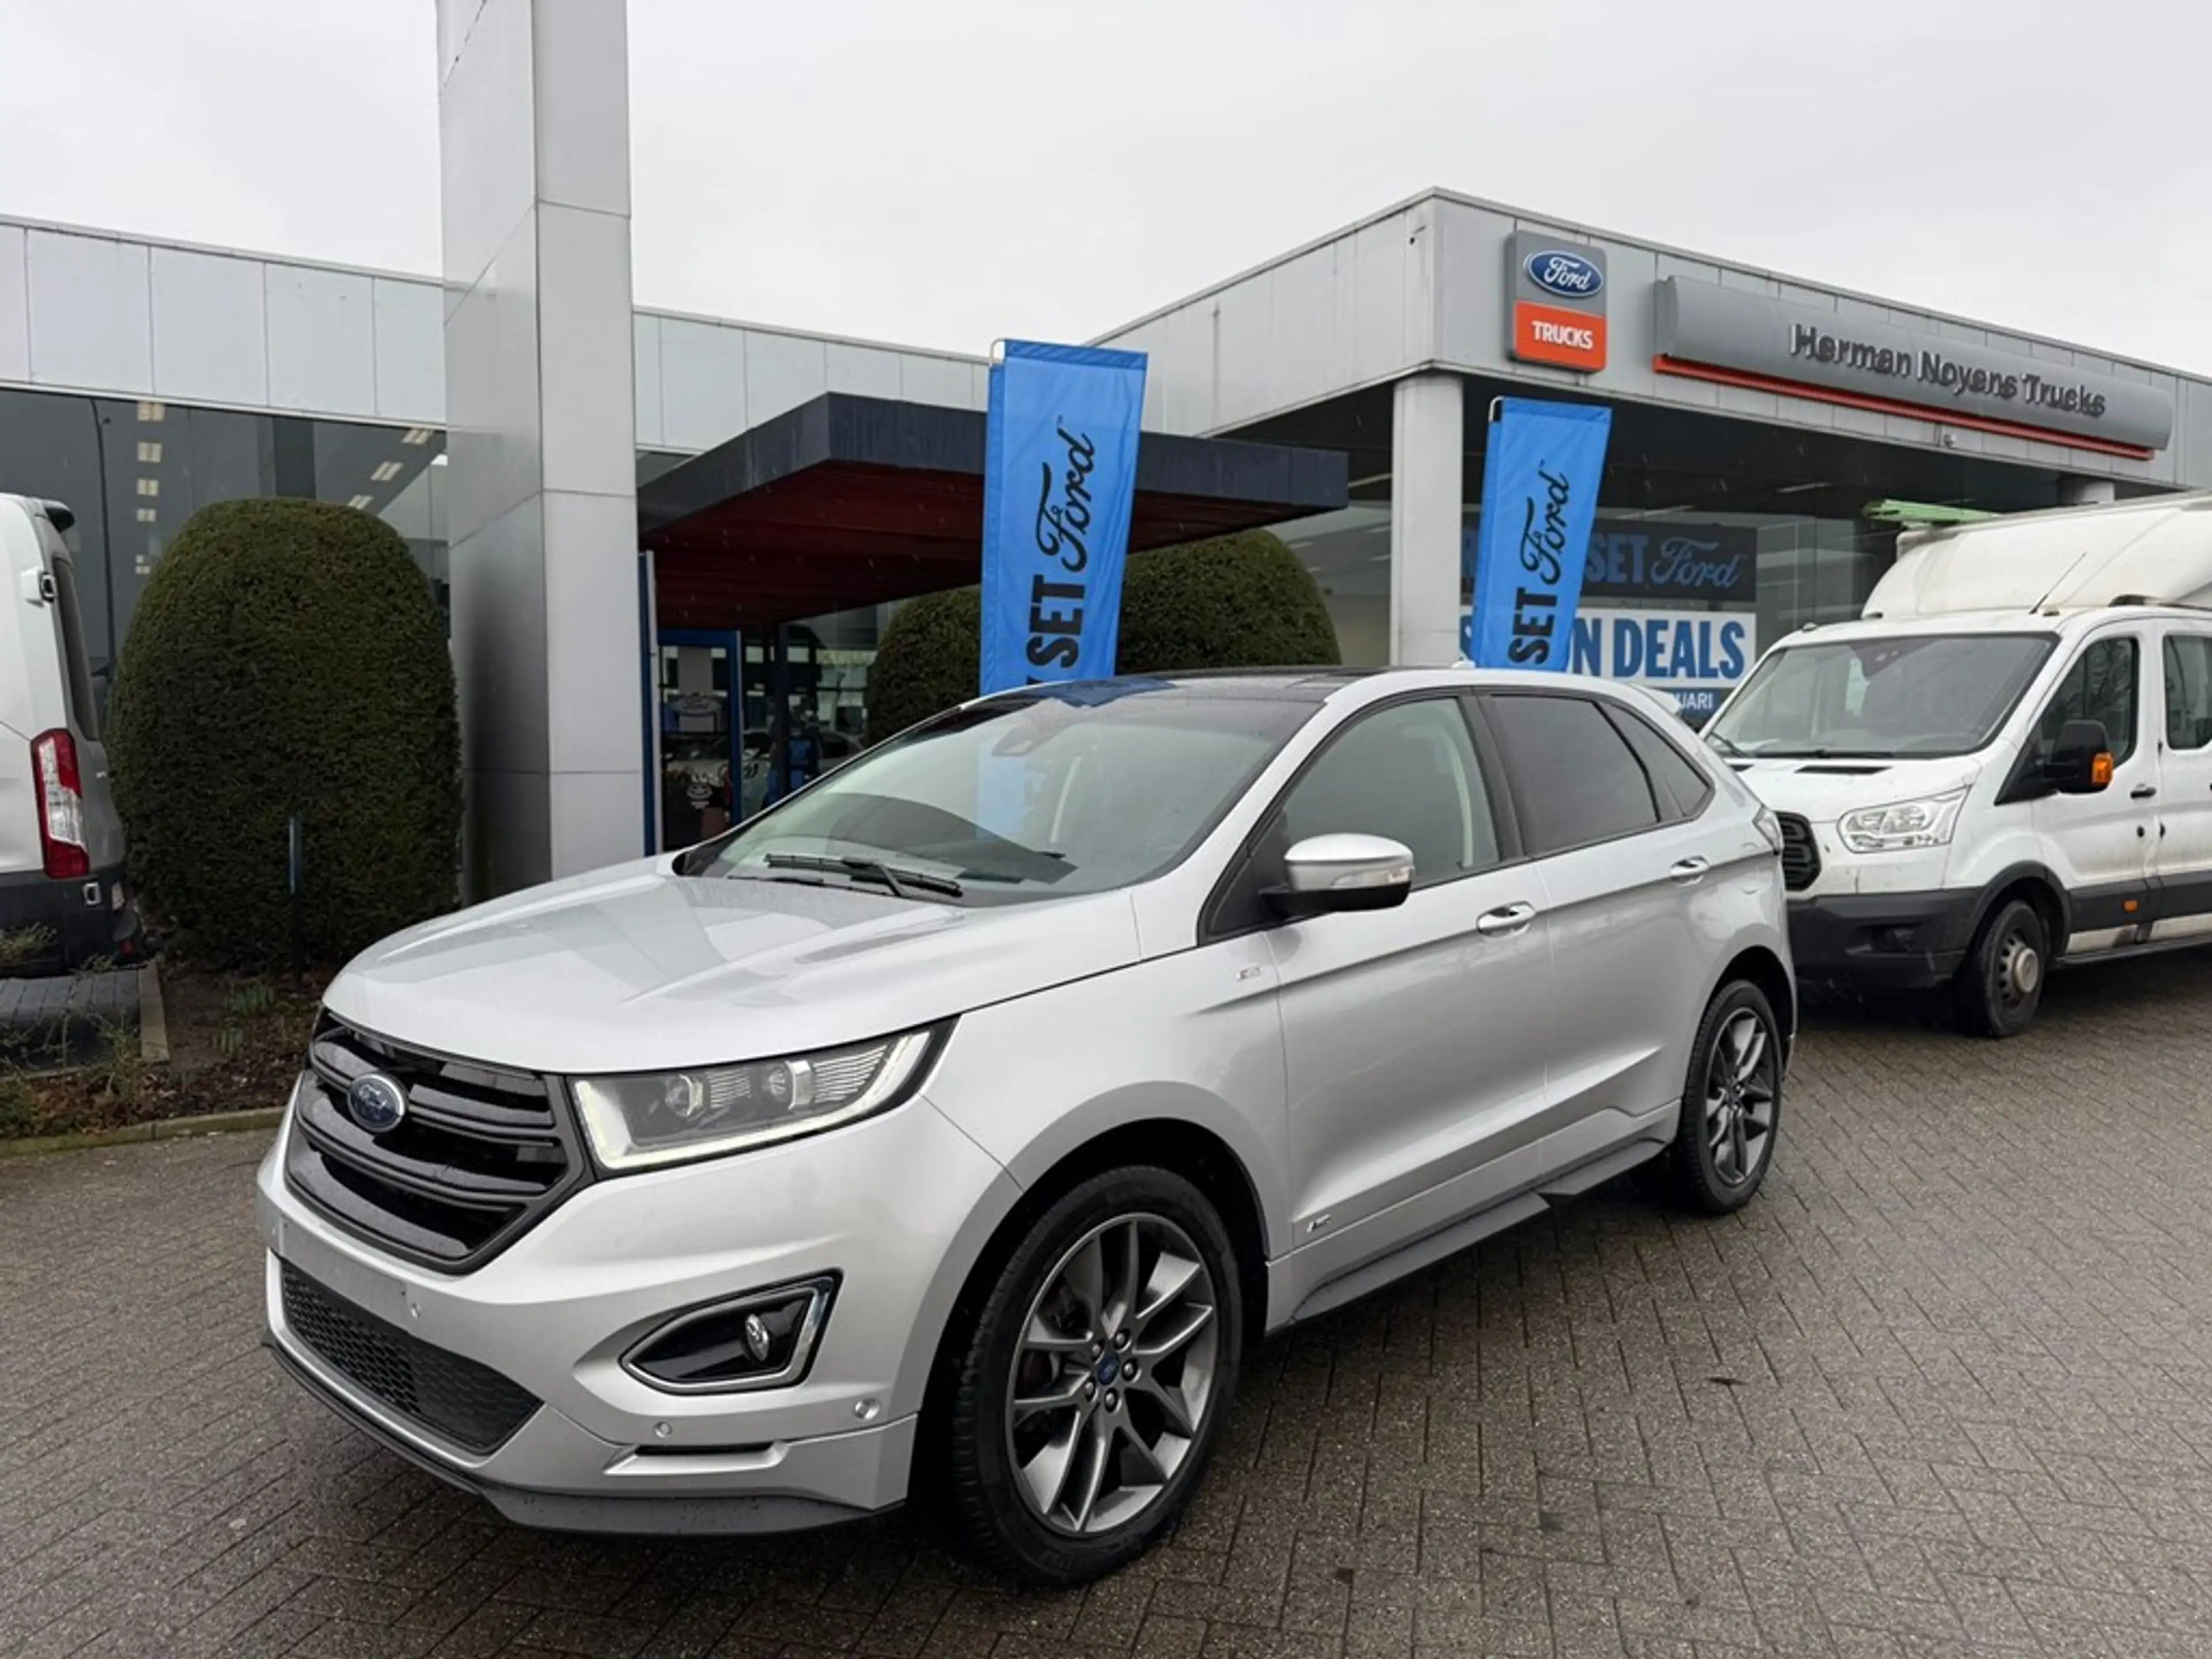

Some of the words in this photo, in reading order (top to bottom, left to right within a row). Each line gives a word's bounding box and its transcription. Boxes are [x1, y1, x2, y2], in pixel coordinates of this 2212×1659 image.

[1544, 256, 1593, 290] Ford
[1532, 320, 1593, 349] TRUCKS
[1790, 323, 1911, 378] Herman
[1917, 351, 2017, 399] Noyens
[2022, 373, 2105, 417] Trucks
[1036, 427, 1095, 572] Ford
[1520, 470, 1570, 585] Ford
[1586, 533, 1649, 584] SET
[1651, 537, 1740, 588] Ford
[1025, 574, 1086, 668] SET
[1508, 587, 1558, 665] SET
[1613, 618, 1745, 679] DEALS
[1676, 692, 1713, 710] UARI
